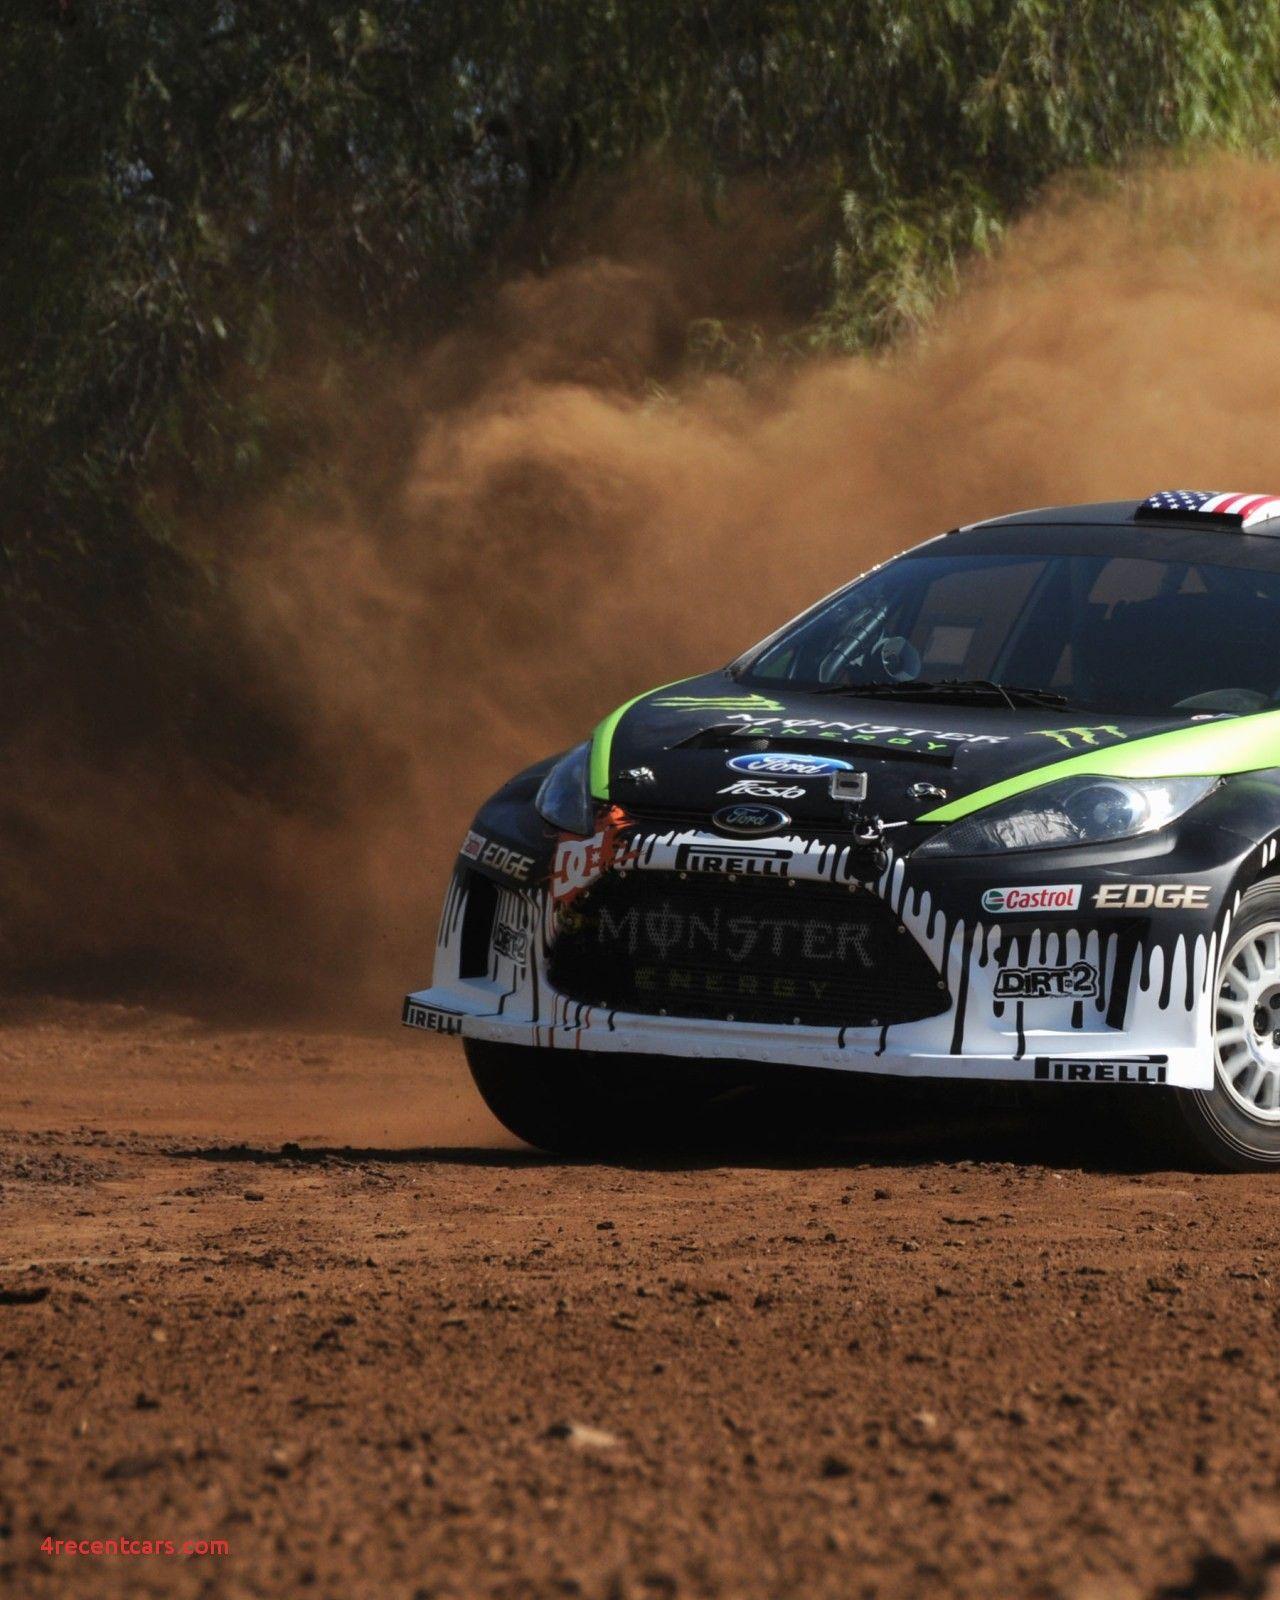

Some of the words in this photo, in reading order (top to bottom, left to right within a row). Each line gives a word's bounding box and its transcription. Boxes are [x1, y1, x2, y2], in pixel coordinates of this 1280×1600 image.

[726, 714, 1010, 743] MONSTER
[748, 727, 947, 750] ENERGY
[747, 755, 829, 775] Ford
[716, 779, 806, 799] Fiesta
[726, 807, 770, 826] Ford
[482, 842, 536, 881] EDGE
[675, 844, 793, 877] PIRELLI
[1006, 888, 1075, 910] Castrol
[1092, 884, 1212, 909] EDGE
[599, 902, 873, 968] MONSTER
[402, 996, 463, 1035] PIRELLI
[1034, 1055, 1168, 1083] PIRELLI
